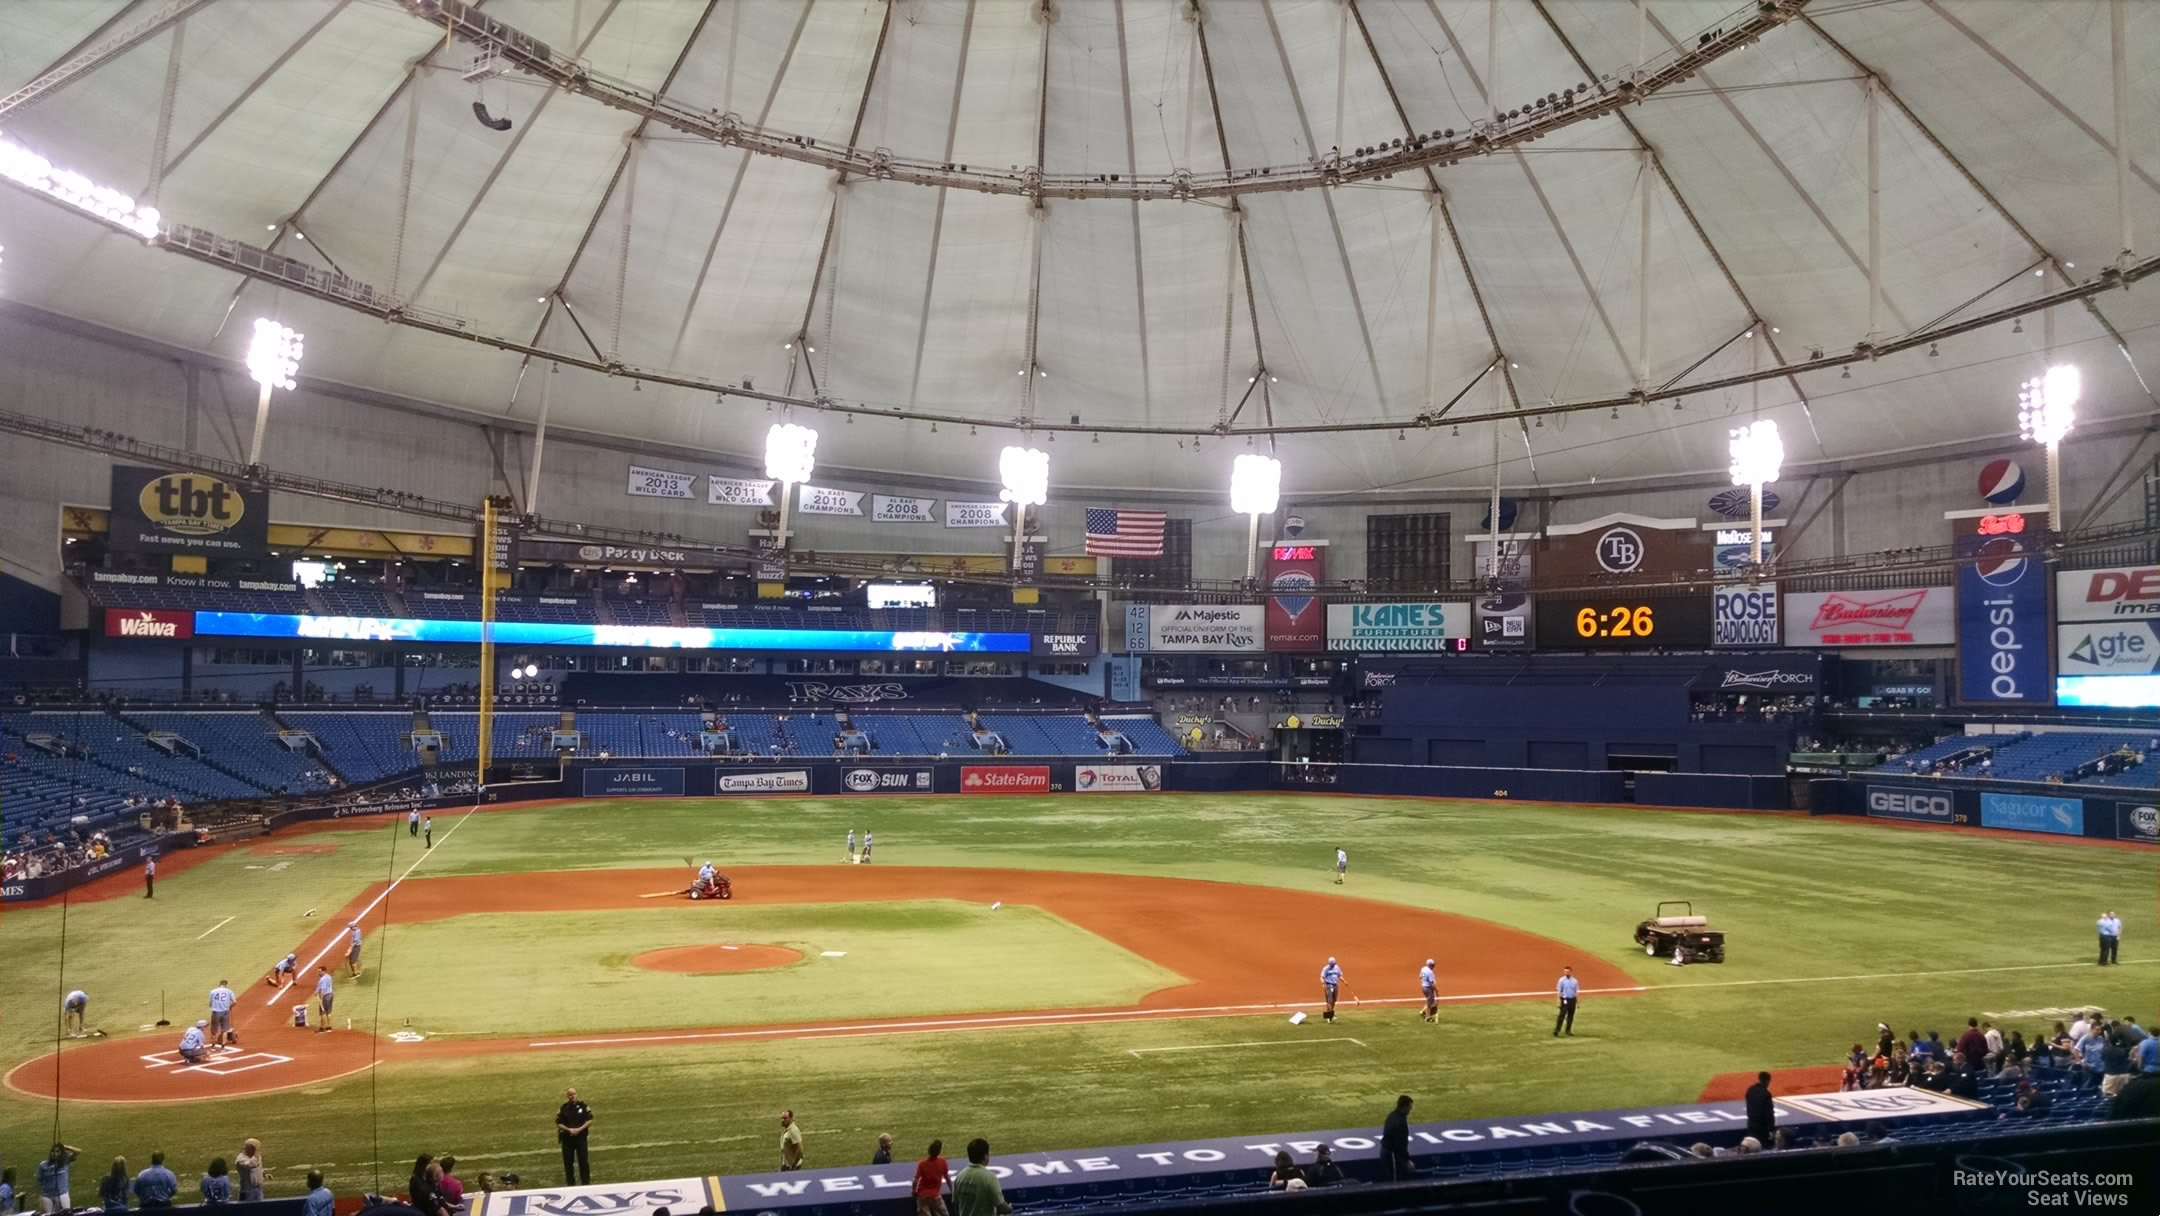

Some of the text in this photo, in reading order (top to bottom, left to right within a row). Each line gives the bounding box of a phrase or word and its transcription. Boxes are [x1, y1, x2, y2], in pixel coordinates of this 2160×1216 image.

[631, 469, 664, 478] AMERICAN
[645, 478, 678, 489] 2013
[711, 479, 743, 487] AMERICAN
[635, 486, 685, 497] WILD CARD
[725, 486, 756, 497] 2011
[715, 495, 737, 503] WILD
[814, 495, 847, 506] 2010
[804, 504, 855, 514] CHAMPIONS
[886, 503, 919, 514] 2008
[960, 509, 992, 519] 2008
[877, 513, 926, 521] CHAMPIONS
[140, 534, 159, 543] Fast
[161, 537, 185, 545] news
[187, 539, 203, 549] you
[205, 539, 221, 547] can
[605, 546, 647, 562] Party
[1274, 547, 1314, 560] RE/MAX
[1605, 537, 1636, 564] TB
[757, 571, 785, 580] buzz?
[94, 572, 297, 592] tampabay.com Know it now. tampabay.com
[2086, 569, 2160, 602] DE
[424, 592, 464, 600] tampabay.com
[540, 597, 577, 605] tampabay.com
[1715, 592, 1776, 620] ROSE
[1820, 603, 1915, 621] Budweiser
[2114, 601, 2160, 614] ima
[1130, 608, 1145, 619] 42
[1193, 610, 1240, 623] Majestic
[1353, 604, 1444, 626] KANE'S
[121, 619, 176, 636] Wawa
[1577, 606, 1653, 637] 6:26
[1132, 622, 1143, 634] 12
[1716, 619, 1776, 643] RADIOLOGY
[1043, 635, 1086, 644] REPUBLIC
[1130, 638, 1145, 649] 66
[1161, 635, 1200, 644] TAMPA
[1203, 635, 1224, 644] BAY
[2099, 632, 2145, 659] gte
[1053, 643, 1078, 652] BANK
[1984, 600, 2023, 698] pepsi
[2107, 653, 2150, 667] financial
[1728, 674, 1813, 683] Budweiser PORCH
[785, 682, 907, 702] RAYS
[1179, 714, 1211, 726] Ducky's
[425, 770, 479, 779] 162 LANDING
[614, 773, 656, 782] JABIL
[853, 774, 872, 783] FOX
[881, 773, 908, 787] SUN
[1100, 774, 1137, 782] TOTAL
[724, 776, 803, 789] Tampa Bay Times
[1870, 792, 1950, 816] GEICO
[1990, 796, 2047, 819] Sagicor
[341, 807, 350, 815] St.
[2138, 812, 2156, 822] FOX
[1955, 814, 1967, 823] 370
[0, 886, 24, 896] MES
[214, 992, 227, 1002] 42
[1799, 1094, 1936, 1113] RAYS
[747, 1156, 1121, 1197] WELOME
[1137, 1148, 1226, 1167] TO
[1244, 1119, 1613, 1157] TROICANA
[502, 1189, 683, 1216] RAYS
